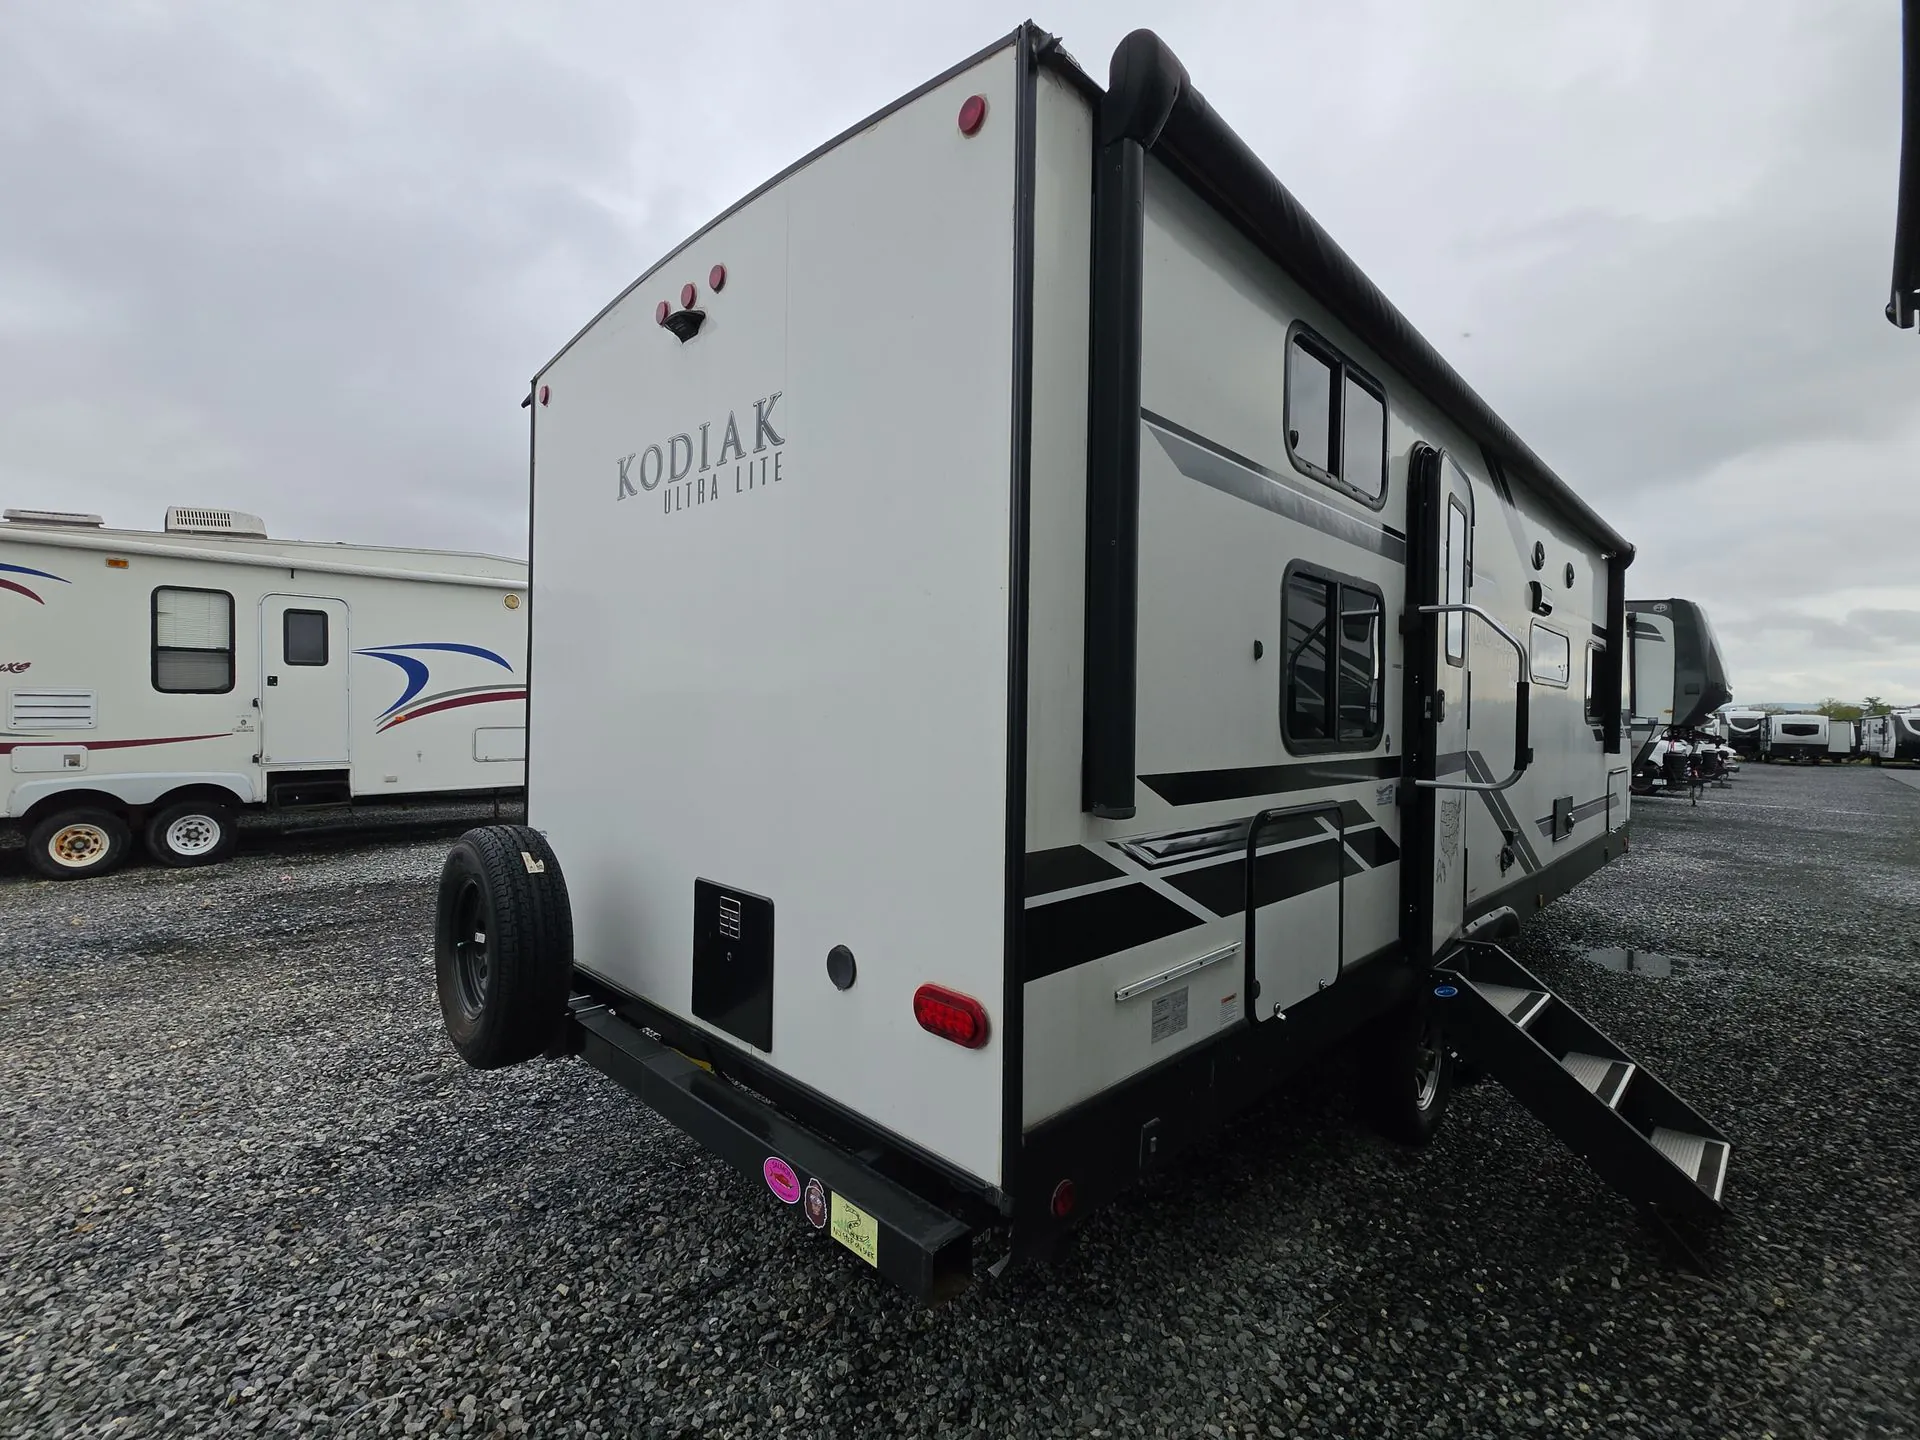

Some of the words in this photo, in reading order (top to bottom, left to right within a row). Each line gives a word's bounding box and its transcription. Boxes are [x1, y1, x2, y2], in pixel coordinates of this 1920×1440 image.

[617, 391, 785, 501] KODIAK
[664, 473, 718, 514] ULTRA
[736, 451, 782, 493] LITE
